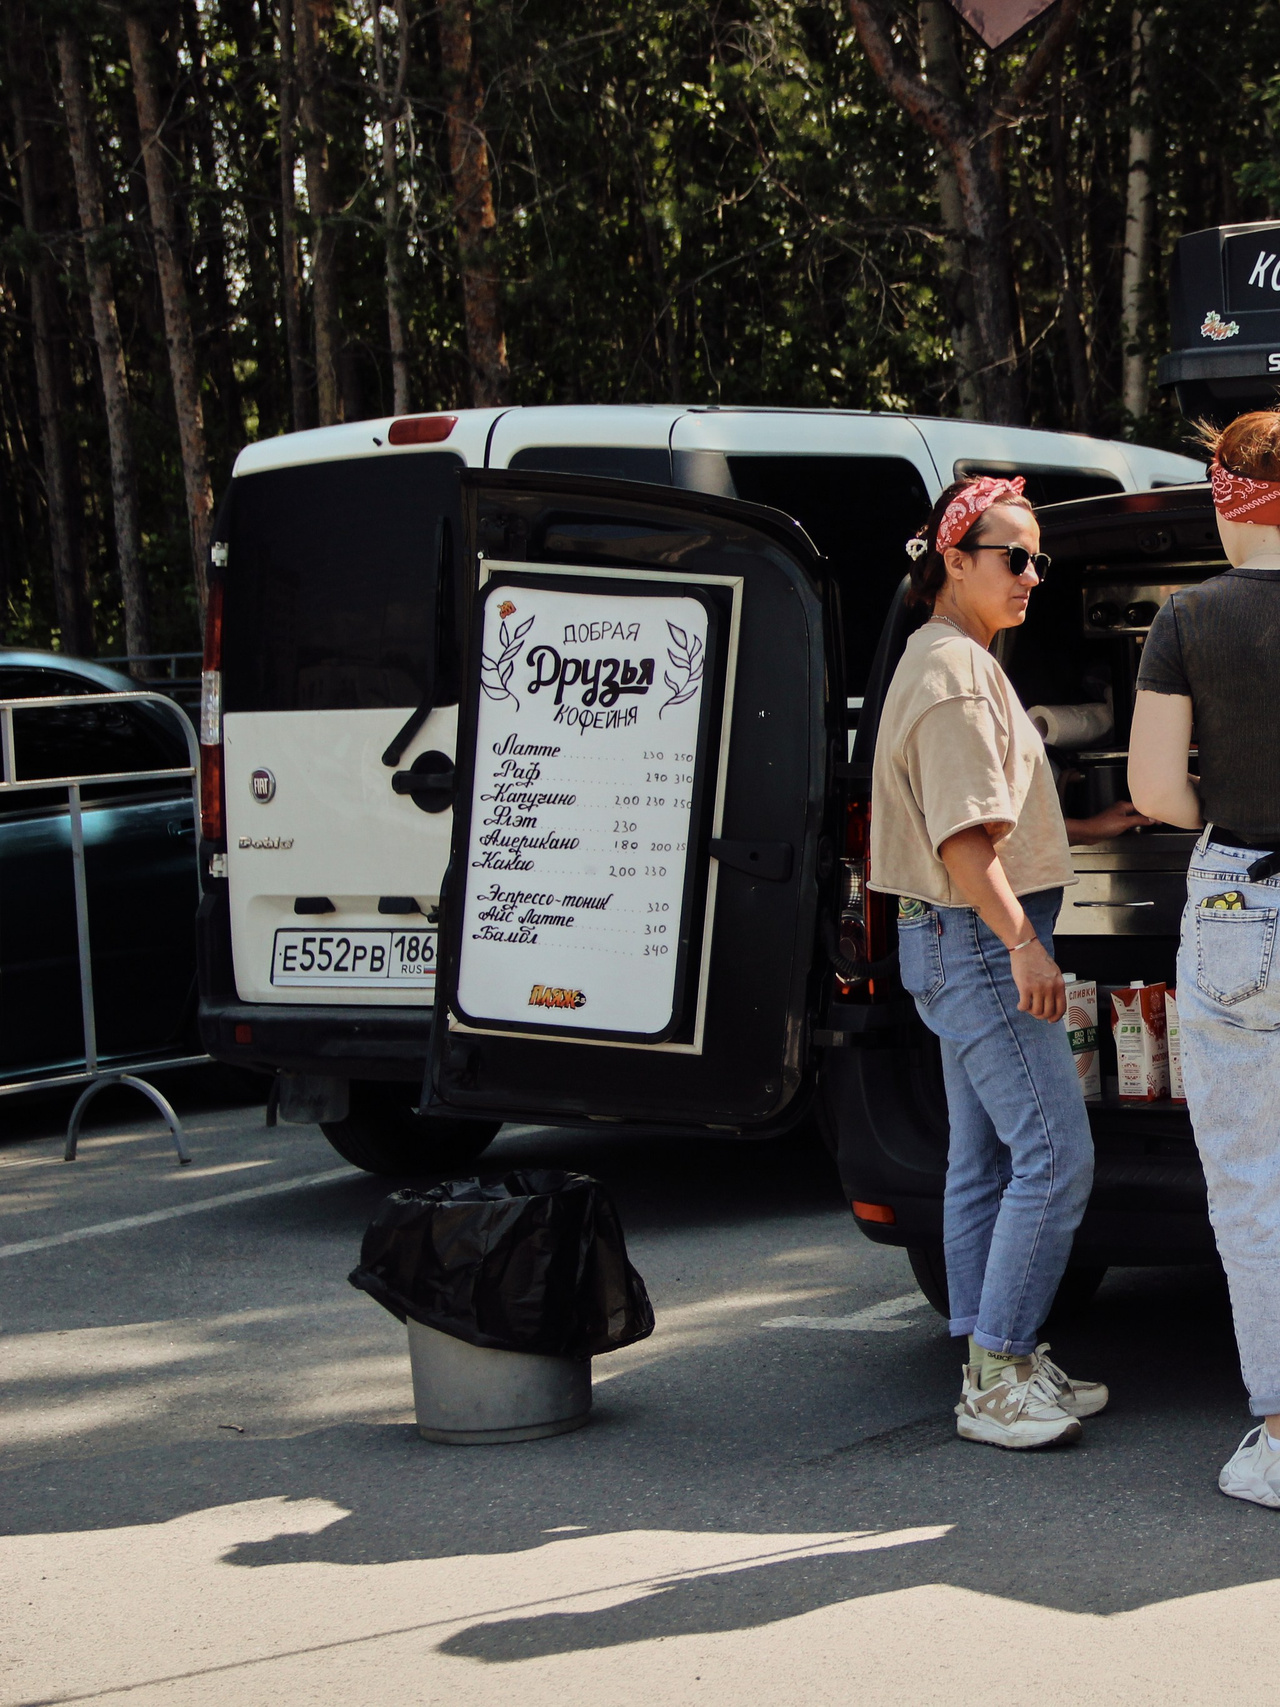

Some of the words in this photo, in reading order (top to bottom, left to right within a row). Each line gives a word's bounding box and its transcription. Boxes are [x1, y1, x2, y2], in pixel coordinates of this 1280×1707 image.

[562, 621, 641, 645] ДОБРАЯ
[526, 645, 655, 707] Друзья
[553, 703, 639, 736] КОФЕЙНЯ
[492, 732, 561, 758] Латте
[643, 751, 664, 760] 230
[674, 753, 694, 763] 250
[253, 776, 269, 795] FIAT
[493, 759, 541, 788] Раф
[673, 774, 693, 785] 310
[480, 783, 577, 811] Капучино
[615, 795, 640, 806] 200
[646, 796, 665, 807] 230
[483, 805, 537, 829] Флэт
[613, 821, 637, 833] 230
[479, 828, 580, 856] Американо
[614, 840, 639, 850] 180
[650, 842, 672, 852] 200
[472, 851, 535, 872] Какао
[609, 865, 636, 878] 200
[645, 865, 667, 877] 230
[477, 883, 614, 912] Эспрессо-тоник
[647, 902, 670, 913] 320
[478, 906, 514, 924] Айс
[518, 907, 575, 928] Латте
[644, 924, 667, 935] 310
[394, 935, 434, 962] 186
[472, 925, 538, 945] Бамбл
[643, 944, 669, 957] 340
[401, 964, 422, 975] RUS
[528, 984, 580, 1010] ПЛЯЖ
[1069, 987, 1096, 1001] СЛИВКИ
